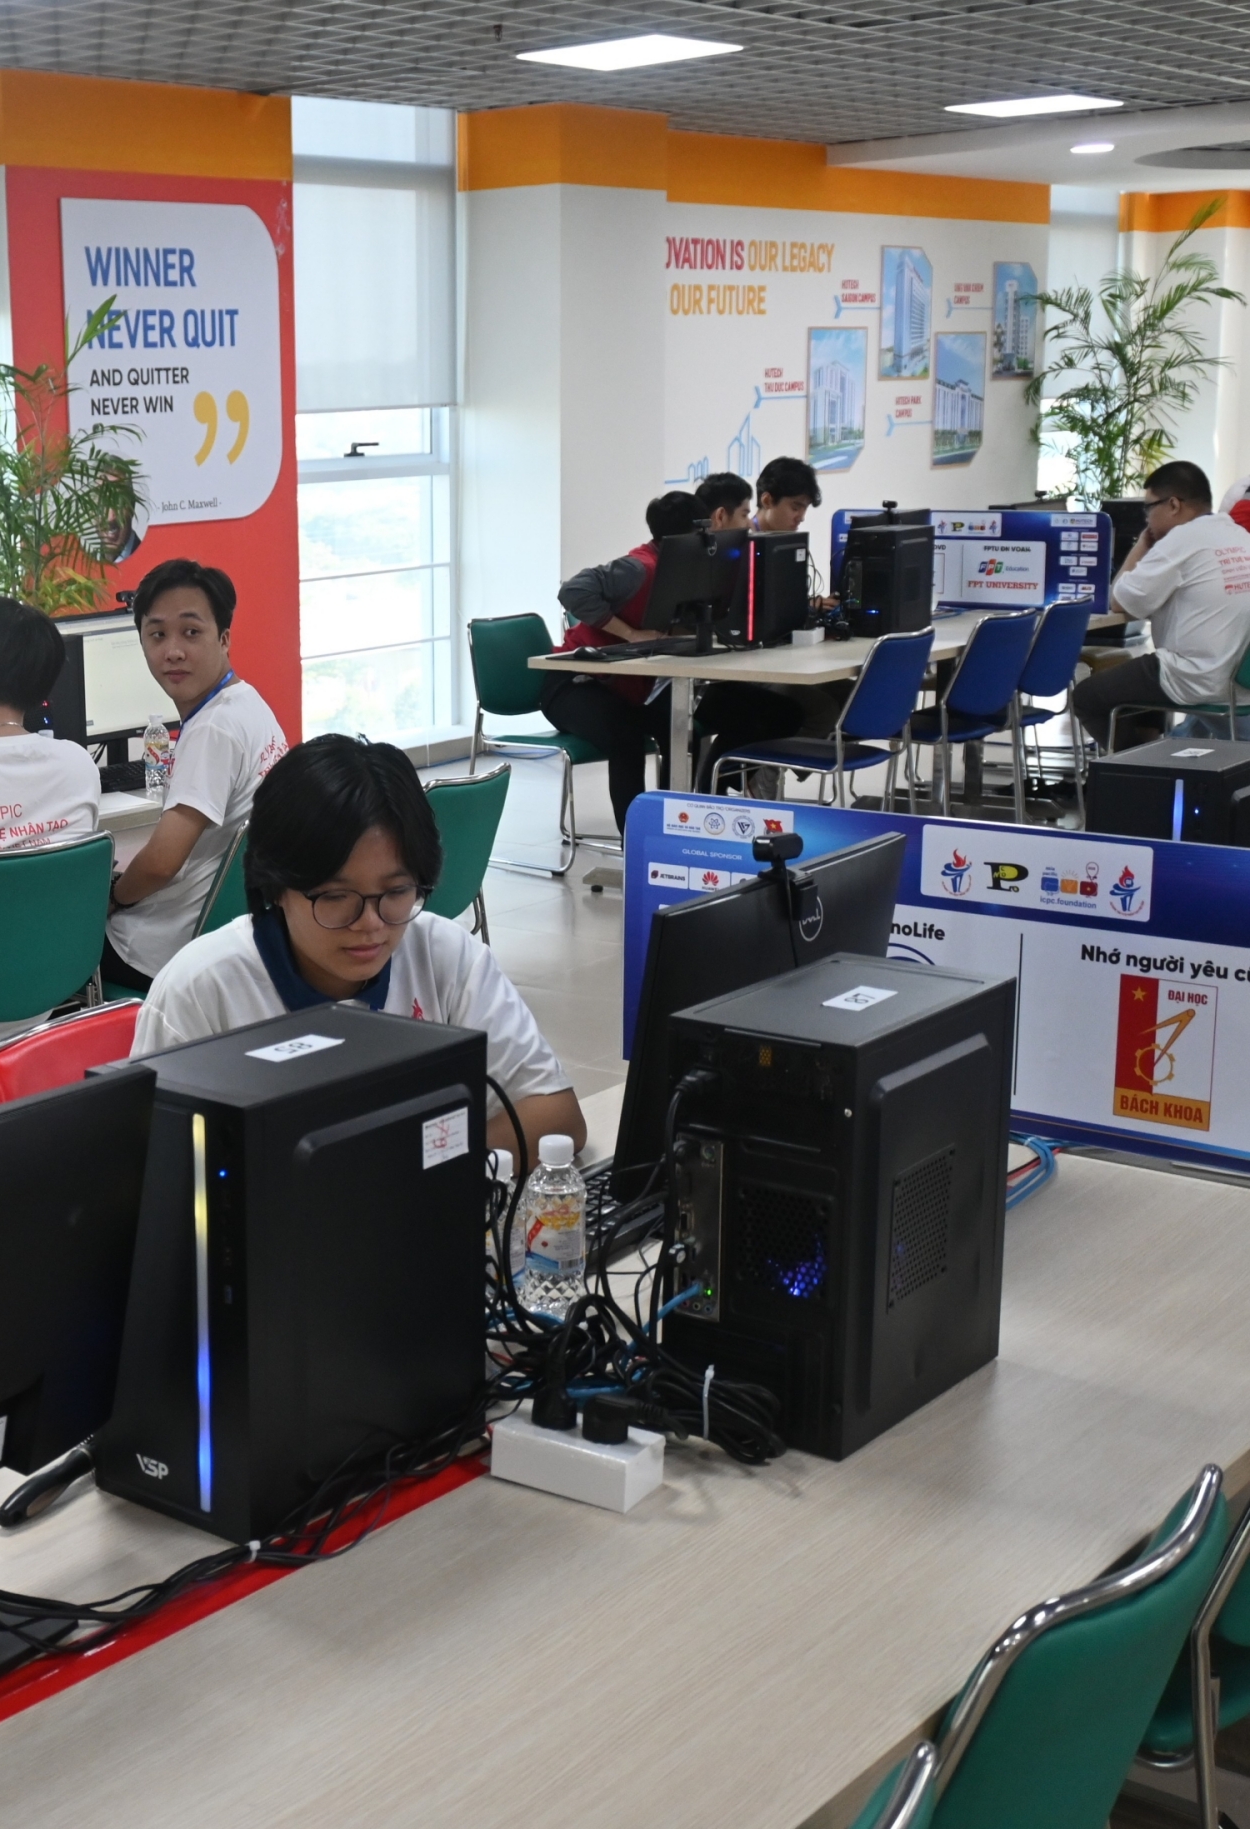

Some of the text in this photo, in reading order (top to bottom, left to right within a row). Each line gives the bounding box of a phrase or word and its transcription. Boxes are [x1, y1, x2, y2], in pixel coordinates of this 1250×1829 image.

[730, 239, 745, 271] IS
[748, 240, 779, 272] OUR
[782, 241, 836, 274] LEGACY
[85, 246, 197, 287] WINNER
[670, 282, 767, 316] OUR FUTURE
[87, 308, 239, 349] NEVER QUIT
[90, 367, 189, 387] AND QUITTER
[785, 381, 804, 391] CAMPUS
[91, 395, 174, 416] NEVER WIN
[161, 500, 178, 514] John
[188, 497, 218, 510] Maxwell
[978, 558, 1004, 576] FPT
[985, 581, 1038, 590] UNIVERSITY
[9, 822, 44, 838] NHÂN
[682, 848, 743, 861] GLOBAL SPONSOR
[1039, 896, 1097, 909] icpc.foundation
[1081, 944, 1250, 982] Nhớ người yêu c
[1168, 990, 1208, 1007] ĐẠI HỌC
[1119, 1093, 1204, 1124] BÁCH KHOA
